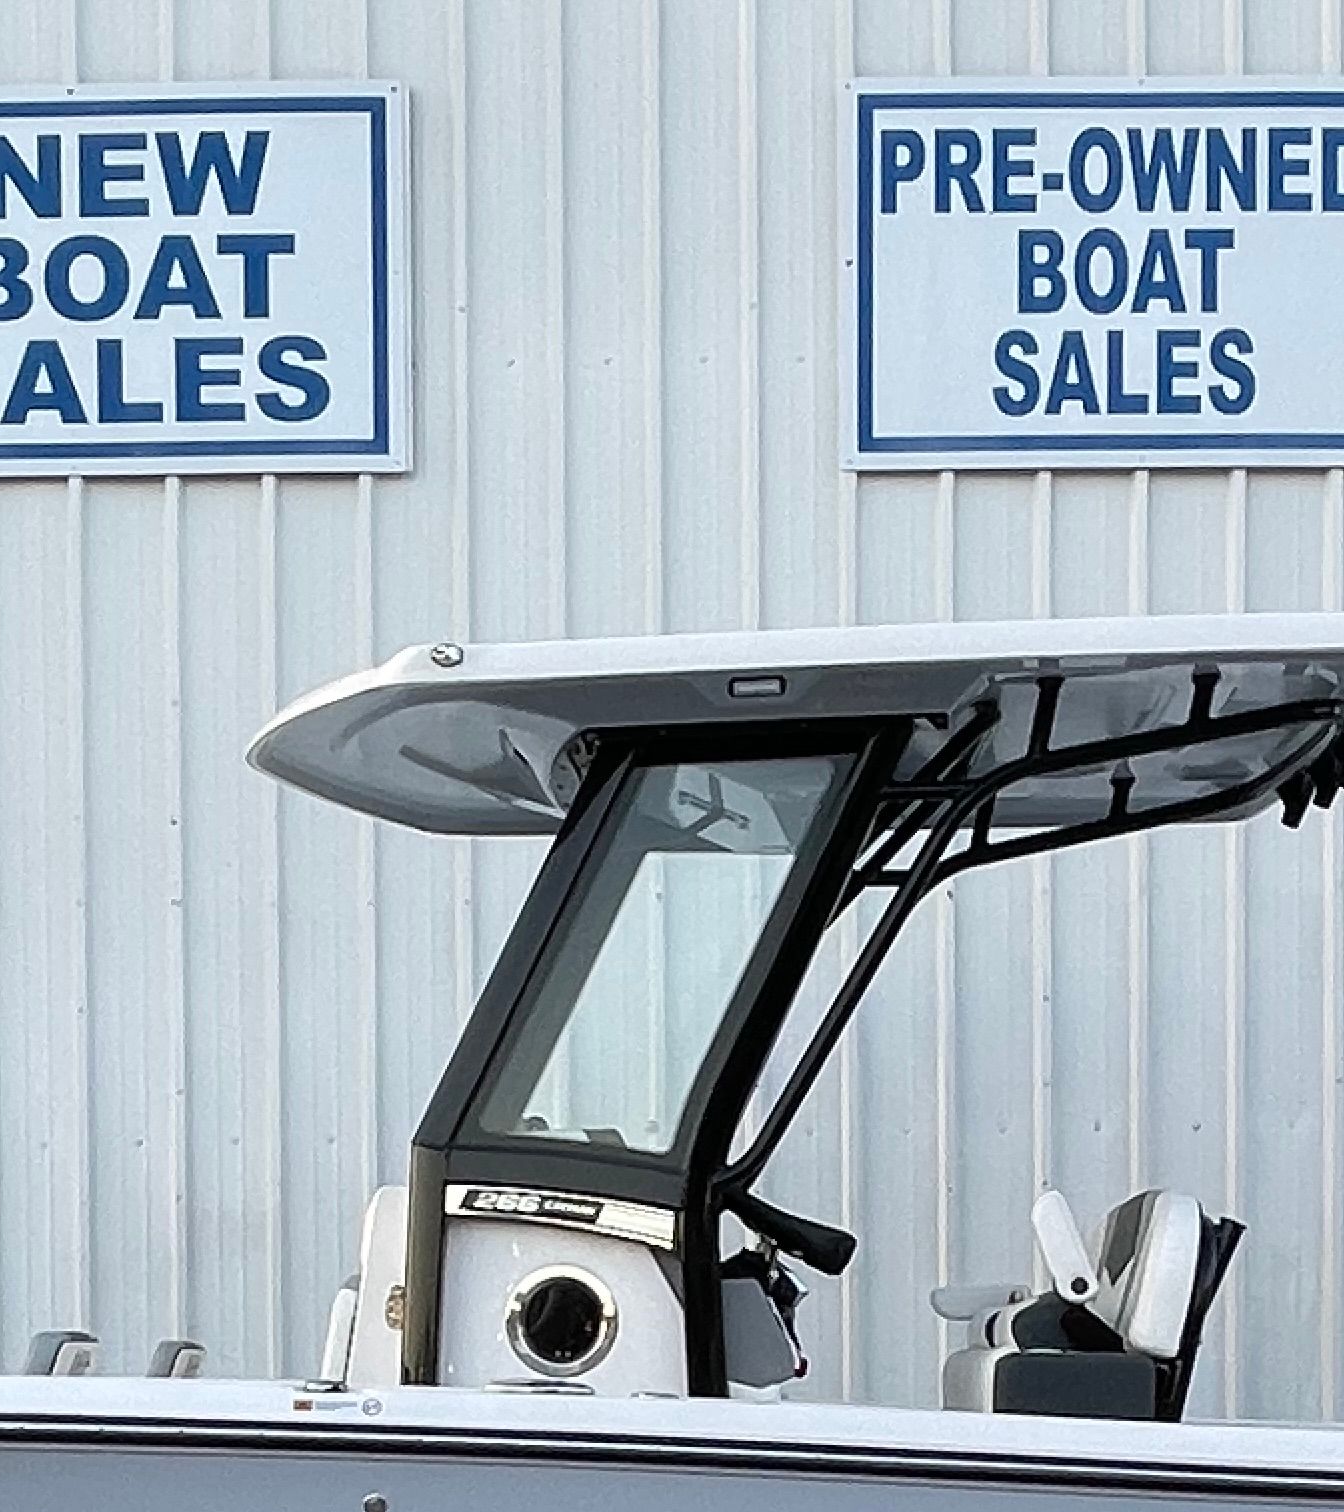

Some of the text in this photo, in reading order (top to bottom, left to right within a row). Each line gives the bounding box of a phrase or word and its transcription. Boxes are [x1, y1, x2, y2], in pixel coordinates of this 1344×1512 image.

[1018, 227, 1235, 315] BOAT
[992, 328, 1256, 417] SALES
[472, 1191, 541, 1213] 266
